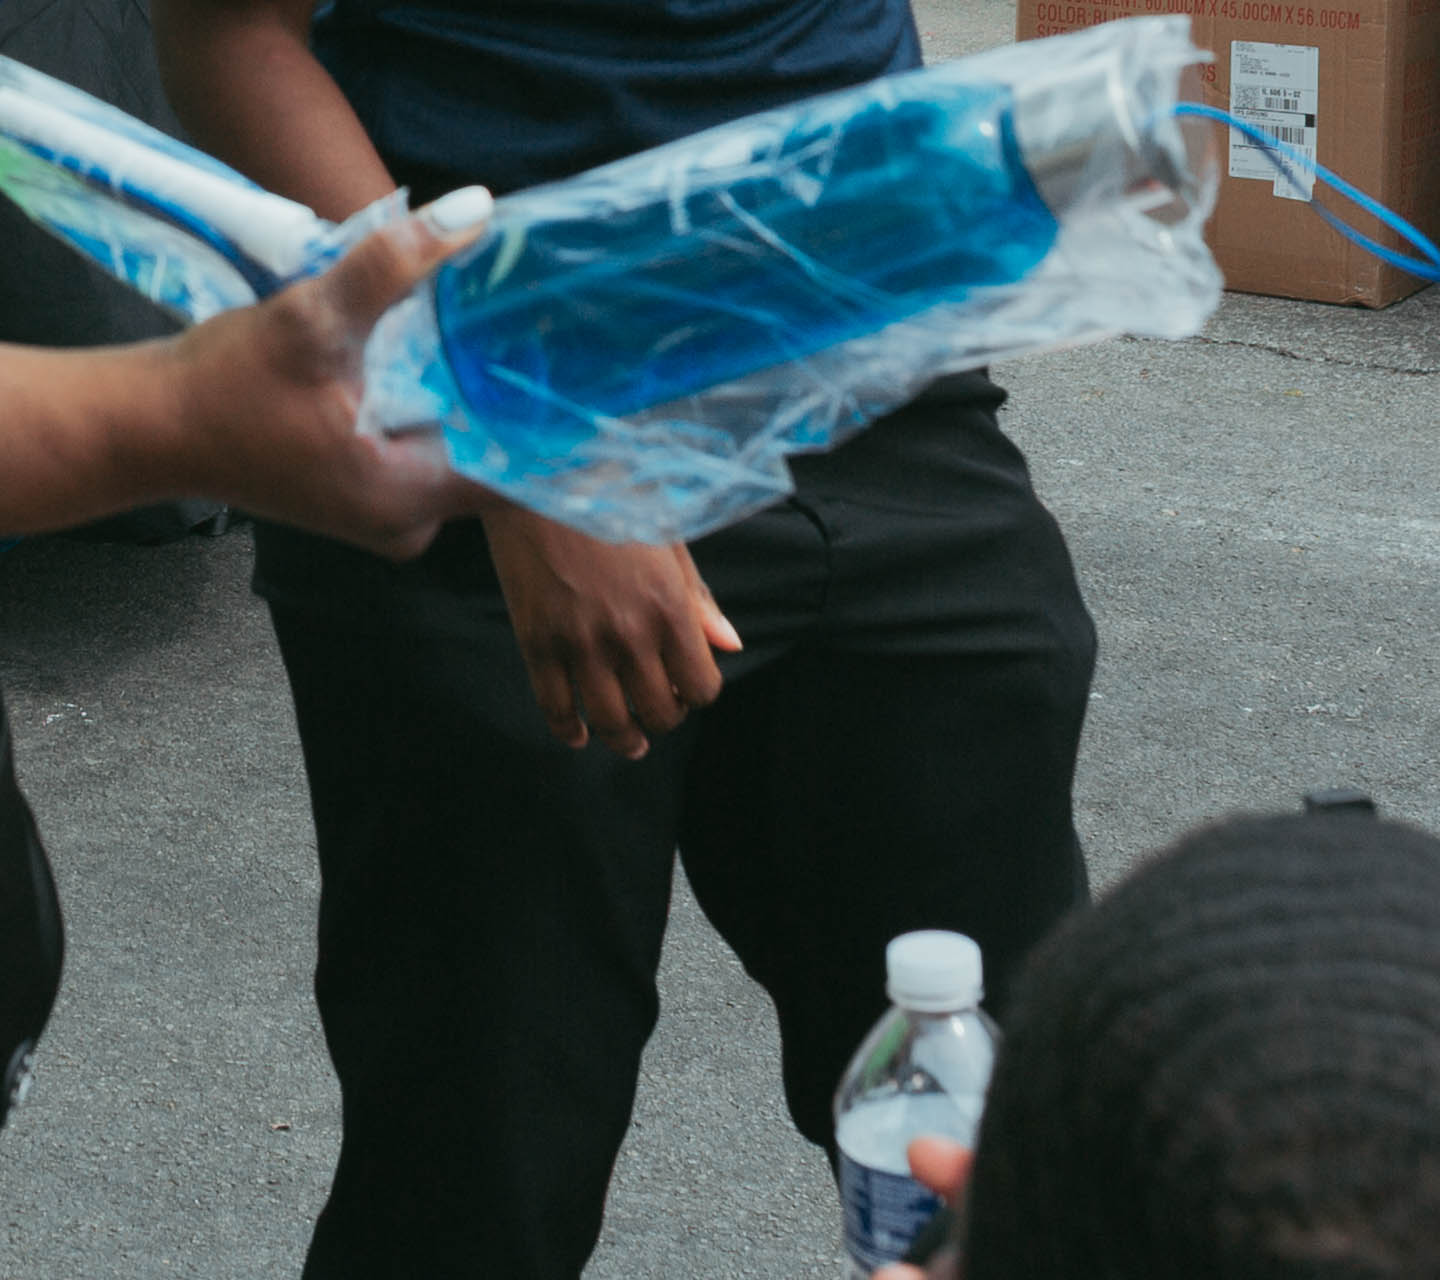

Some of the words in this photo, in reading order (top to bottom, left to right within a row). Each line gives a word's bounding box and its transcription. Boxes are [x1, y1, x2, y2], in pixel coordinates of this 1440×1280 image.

[1037, 2, 1132, 25] COLOR:BL
[1221, 0, 1283, 24] 45.00CM
[1285, 6, 1294, 25] X
[1297, 8, 1360, 31] 56.00CM
